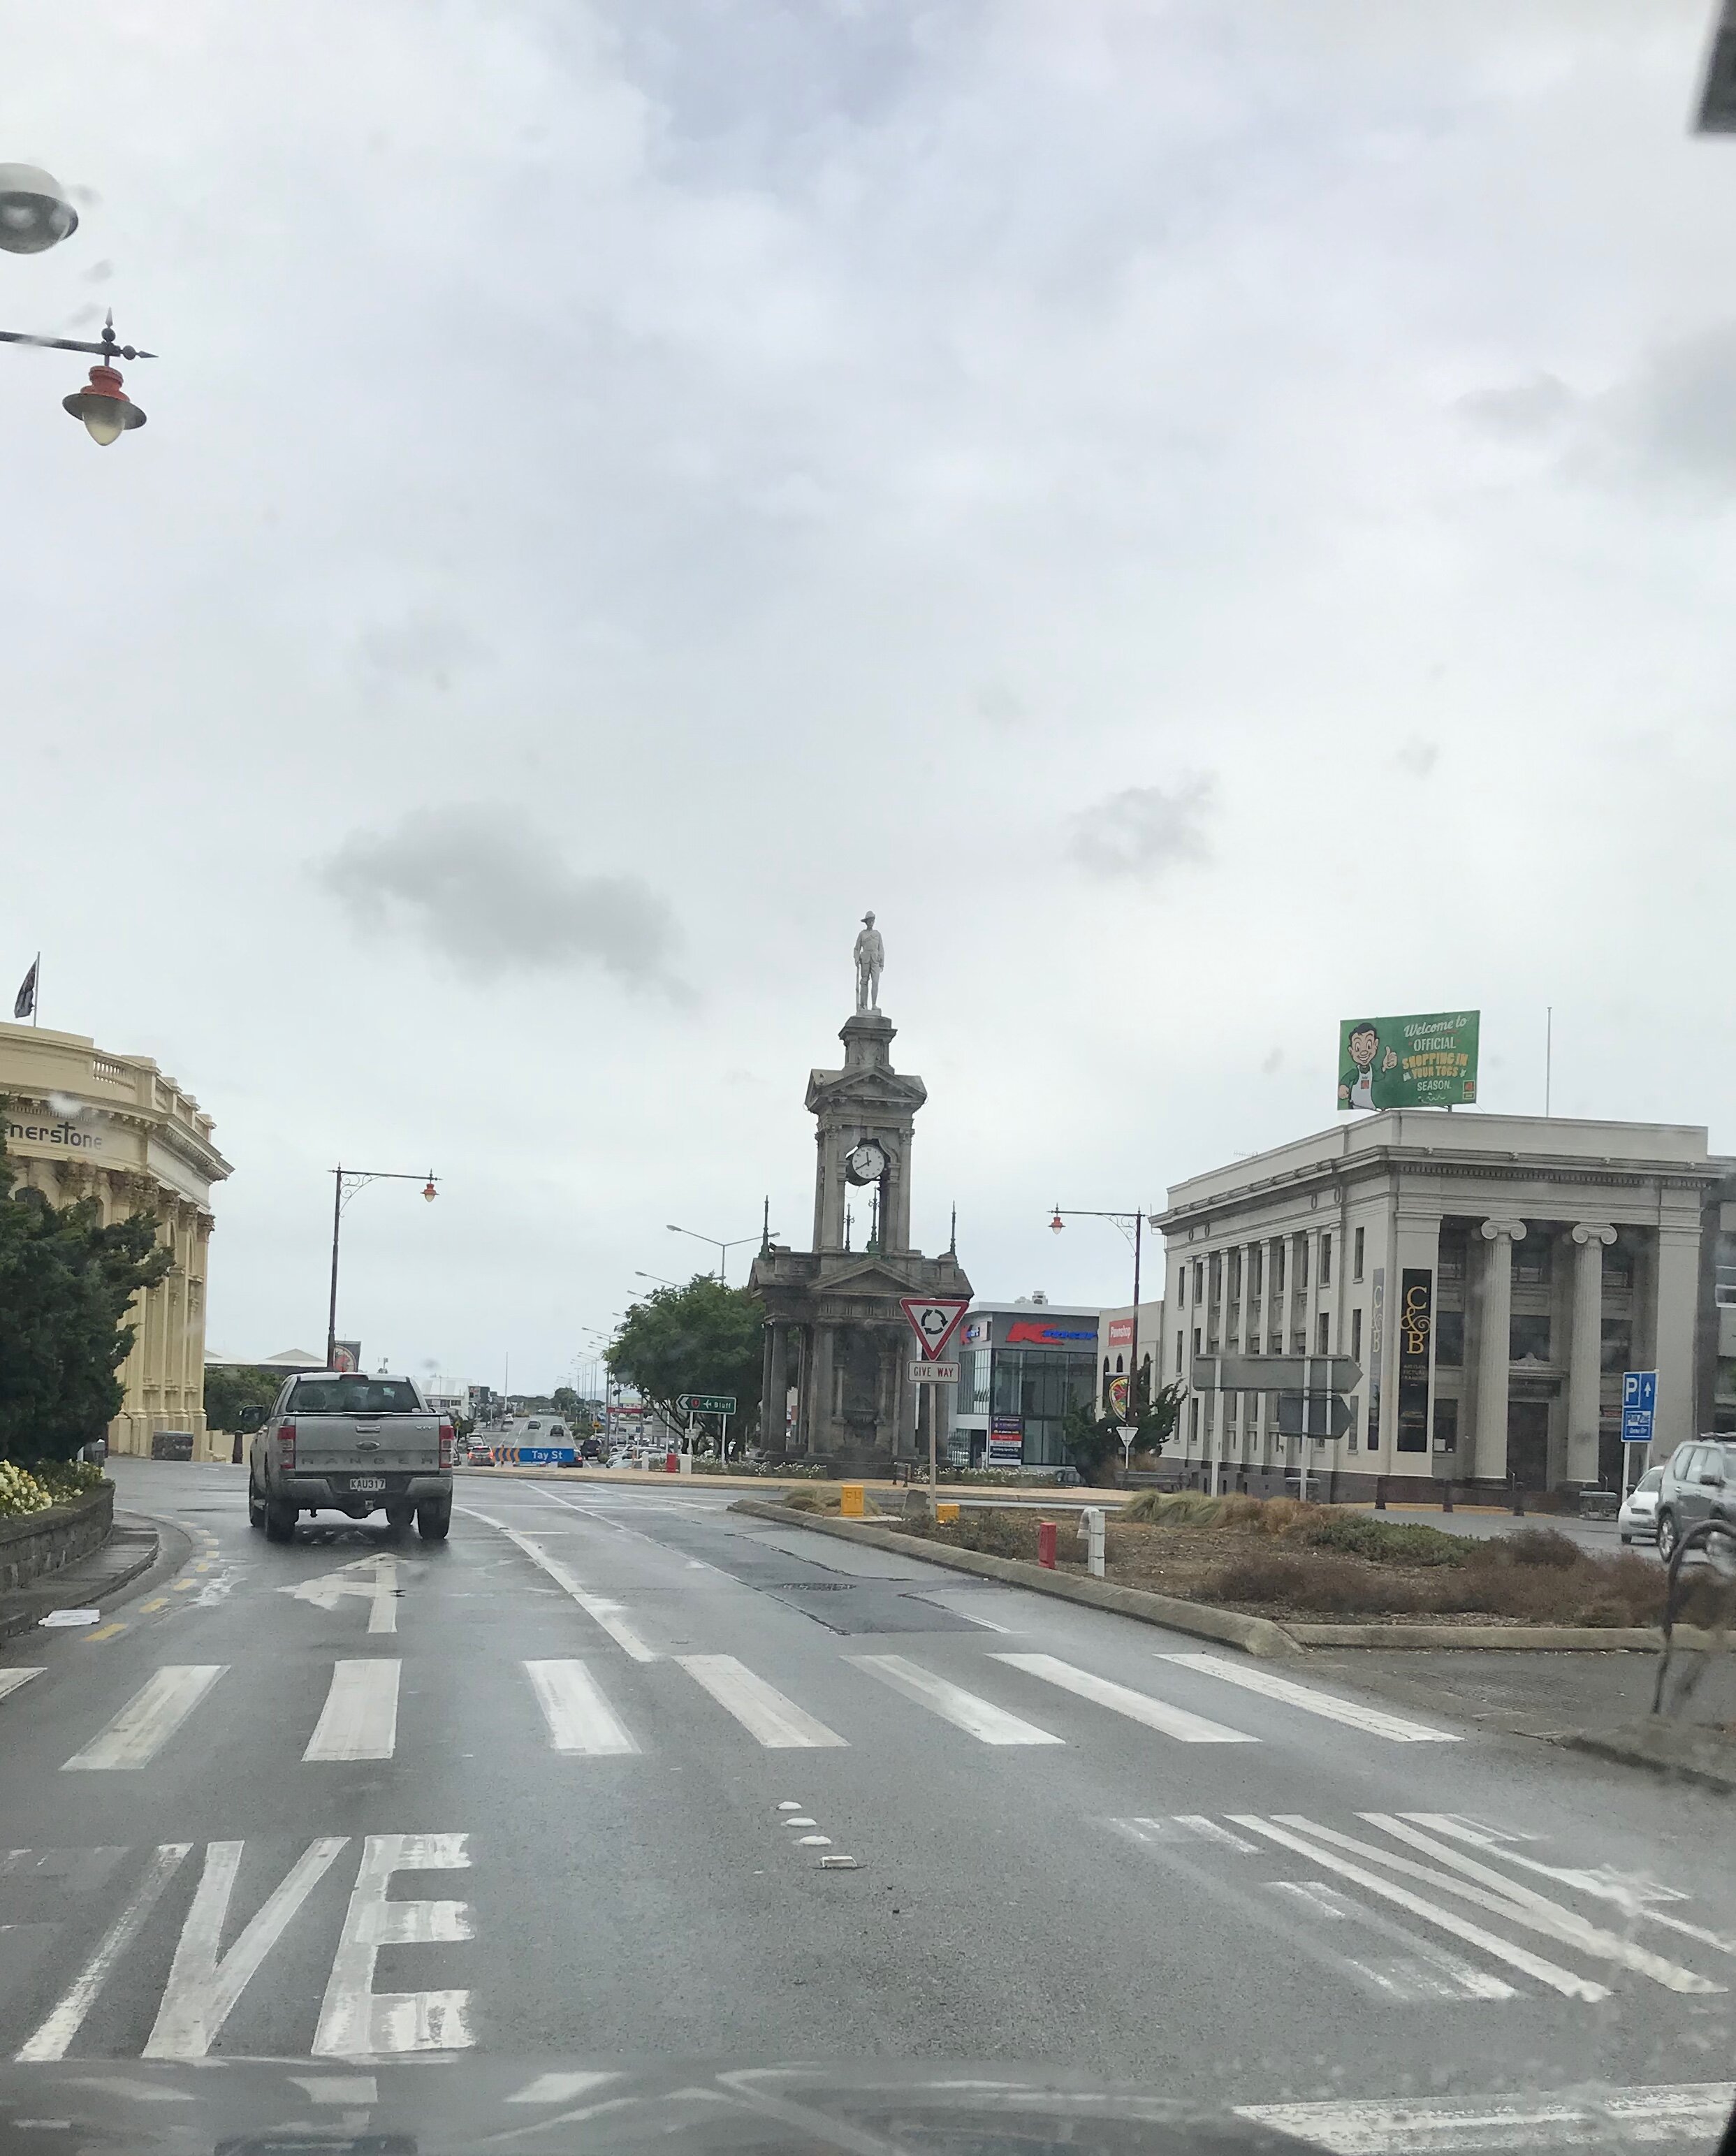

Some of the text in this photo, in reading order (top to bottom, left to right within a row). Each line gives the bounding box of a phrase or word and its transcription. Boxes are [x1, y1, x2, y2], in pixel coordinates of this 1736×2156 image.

[1403, 1015, 1468, 1037] Welcome to
[1413, 1037, 1457, 1051] OFFICIAL
[1401, 1052, 1468, 1070] SHOPPING IN
[1411, 1065, 1459, 1079] YOUR TOGS
[10, 1121, 102, 1150] nerstone
[1110, 1325, 1131, 1339] Pawnshop
[914, 1367, 954, 1378] GIVE WAY
[1626, 1377, 1638, 1401] P
[532, 1450, 563, 1460] Tay St
[351, 1479, 385, 1489] KAU317
[0, 1833, 476, 2062] IVE
